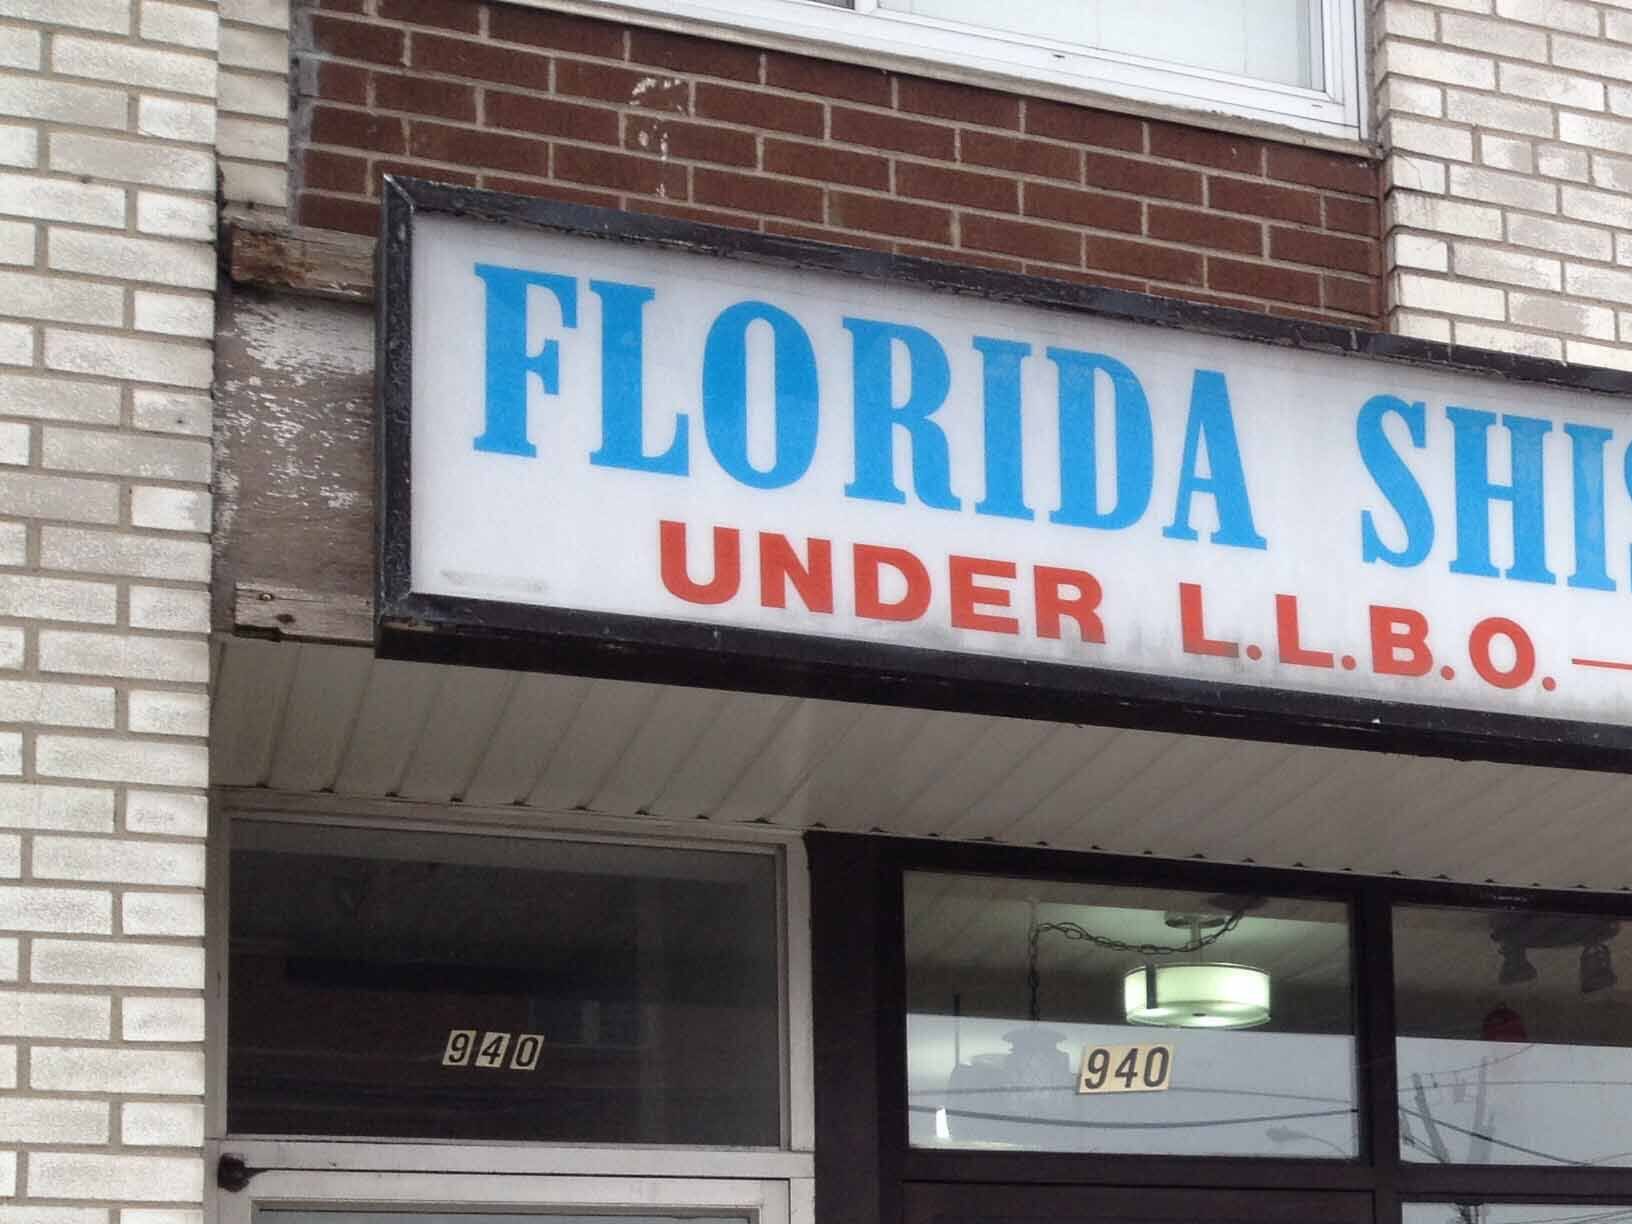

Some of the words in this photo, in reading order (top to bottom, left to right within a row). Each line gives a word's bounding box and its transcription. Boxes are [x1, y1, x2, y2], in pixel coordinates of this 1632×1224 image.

[473, 262, 1268, 550] FLORIDA
[659, 519, 1106, 645] UNDER
[1178, 581, 1557, 692] L.L.B.O.
[448, 1032, 540, 1067] 940
[1084, 1046, 1170, 1090] 940
